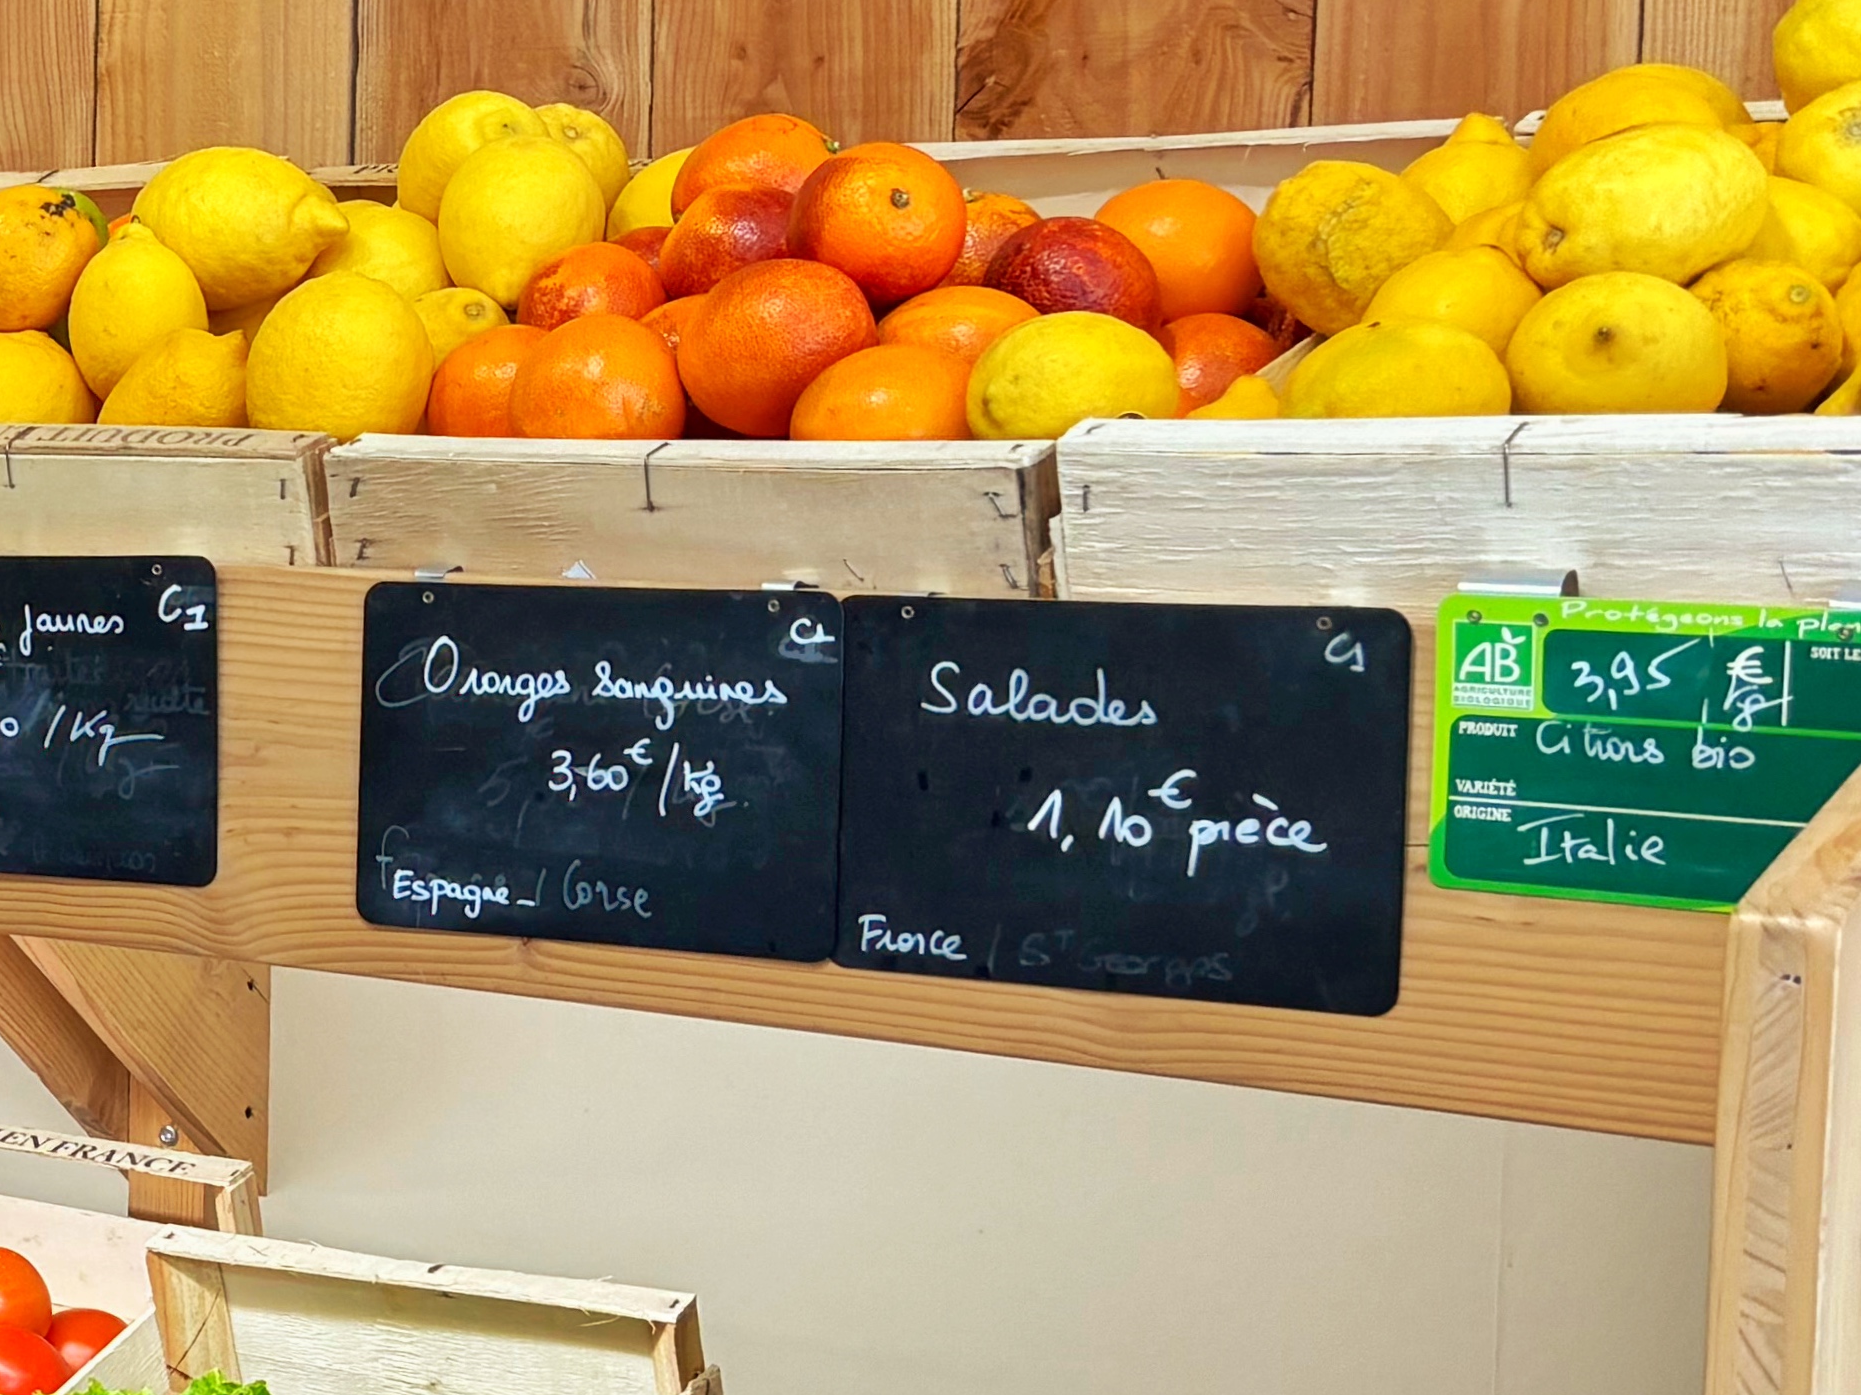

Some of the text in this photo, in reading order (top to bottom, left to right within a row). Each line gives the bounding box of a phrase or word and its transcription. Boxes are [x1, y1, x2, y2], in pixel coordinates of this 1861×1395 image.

[157, 584, 210, 632] C1
[1559, 600, 1784, 635] Protégeons la
[1458, 640, 1522, 685] AB
[1809, 645, 1842, 660] SOIT
[423, 635, 572, 723] Oranges
[920, 659, 1158, 728] Salades
[1452, 695, 1533, 708] BIOLOGIQUE
[1453, 685, 1533, 698] AGRICULTURE
[1457, 720, 1518, 738] PRODUIT
[1535, 718, 1756, 770] Citrons bio
[1455, 777, 1517, 797] VARIÉTÉ
[1188, 792, 1330, 878] pièce
[1452, 805, 1513, 822] ORIGINE
[1517, 813, 1668, 866] Italie
[392, 867, 511, 920] Espagne
[857, 912, 968, 962] France
[48, 1135, 197, 1177] FRANCE
